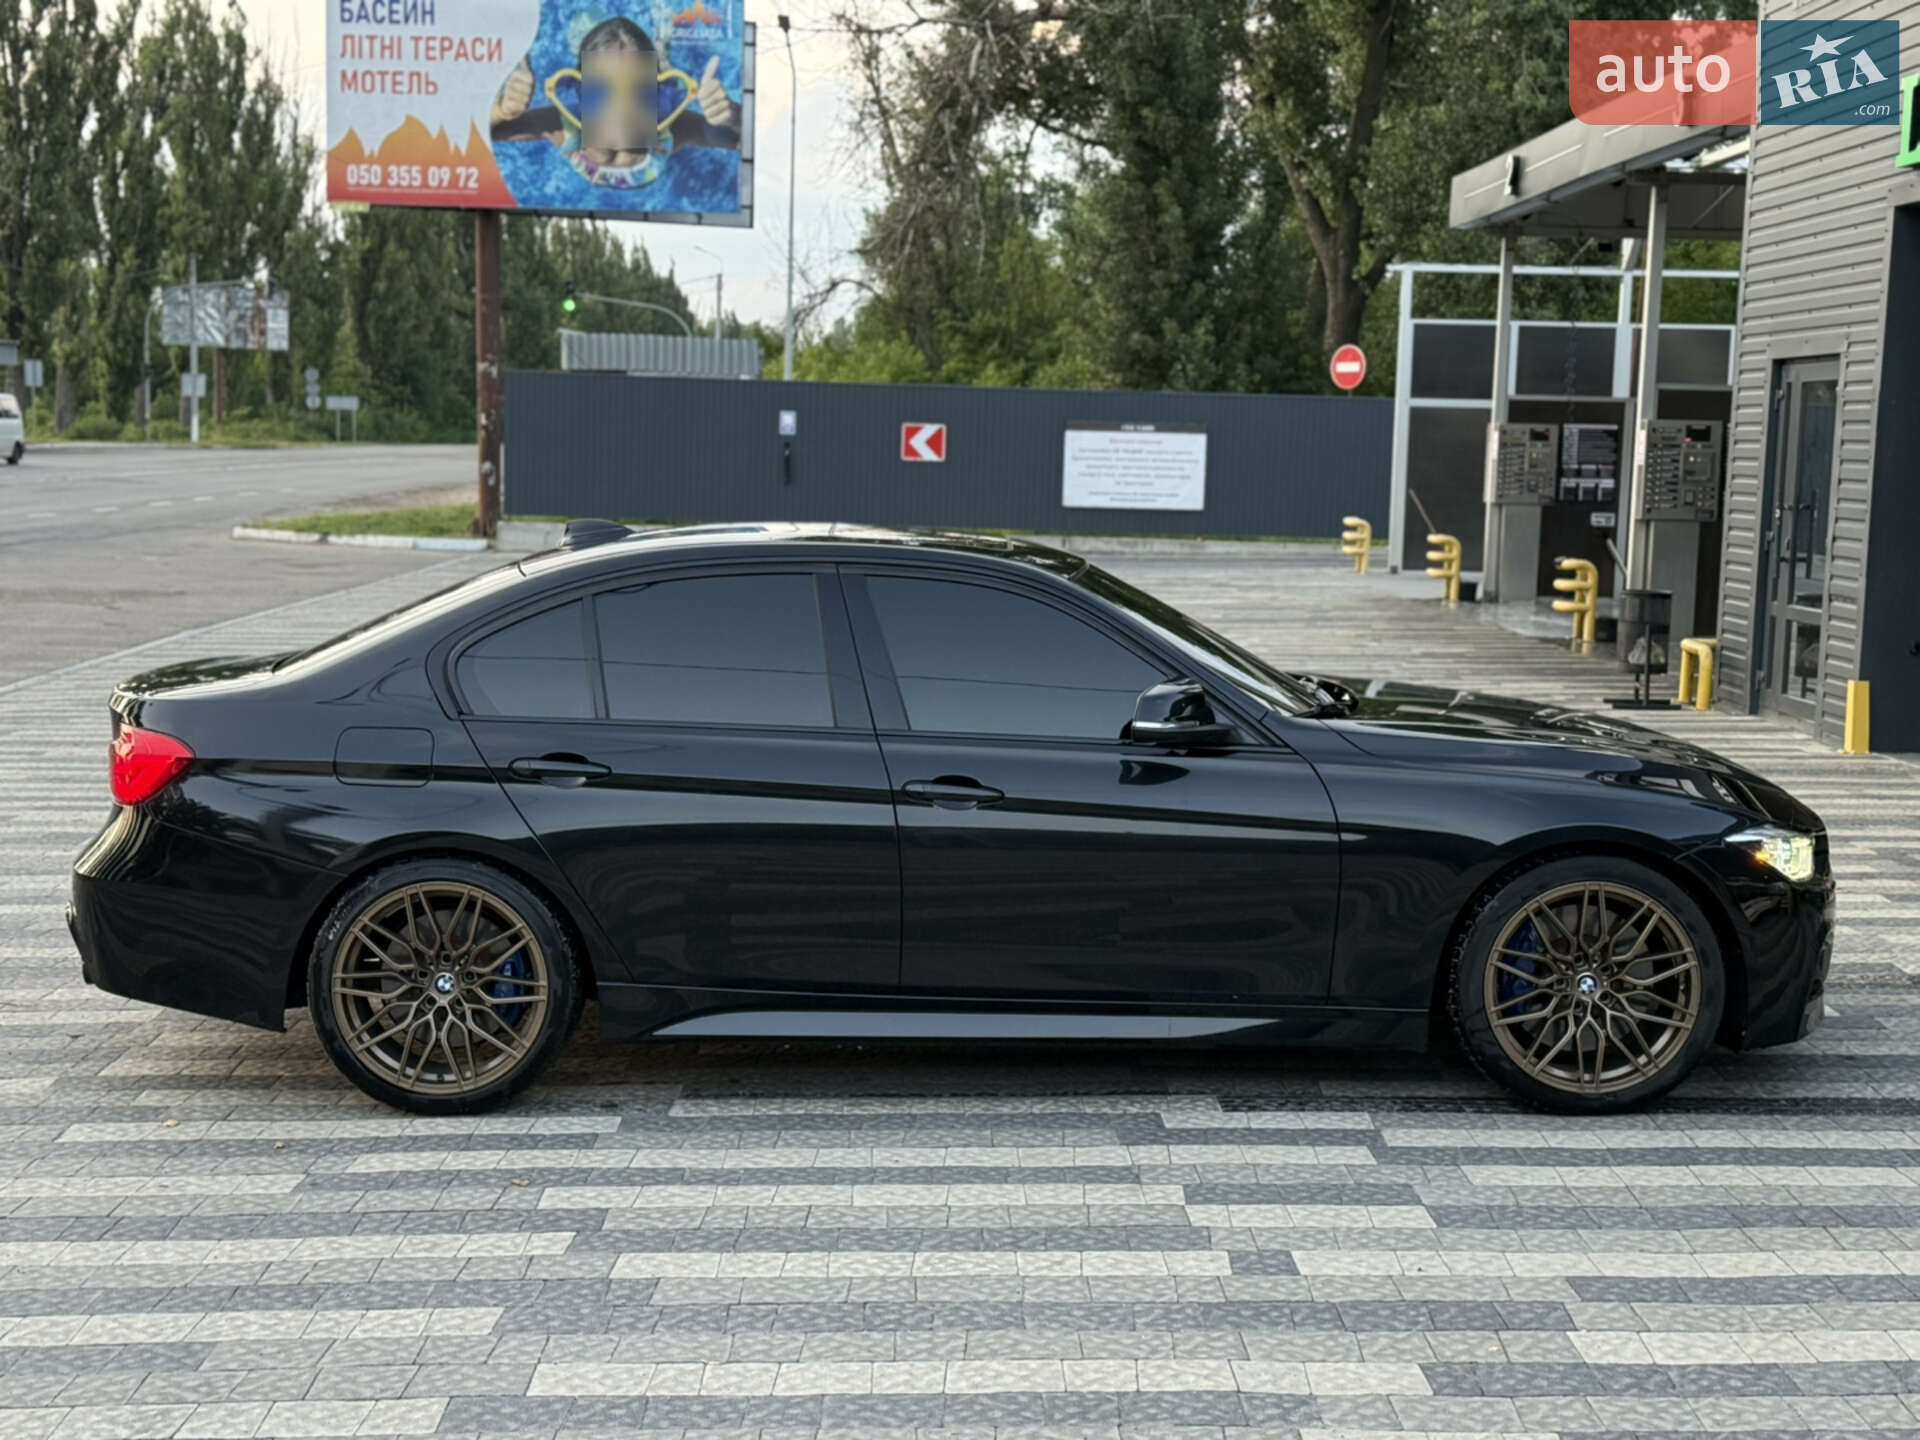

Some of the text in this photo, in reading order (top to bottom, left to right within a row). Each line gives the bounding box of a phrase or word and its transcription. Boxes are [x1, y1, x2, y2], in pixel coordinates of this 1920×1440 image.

[340, 34, 503, 63] ЛІТНІ ТЕРАСИ
[340, 70, 439, 95] МОТЕЛЬ
[346, 163, 480, 189] 050 355 09 72
